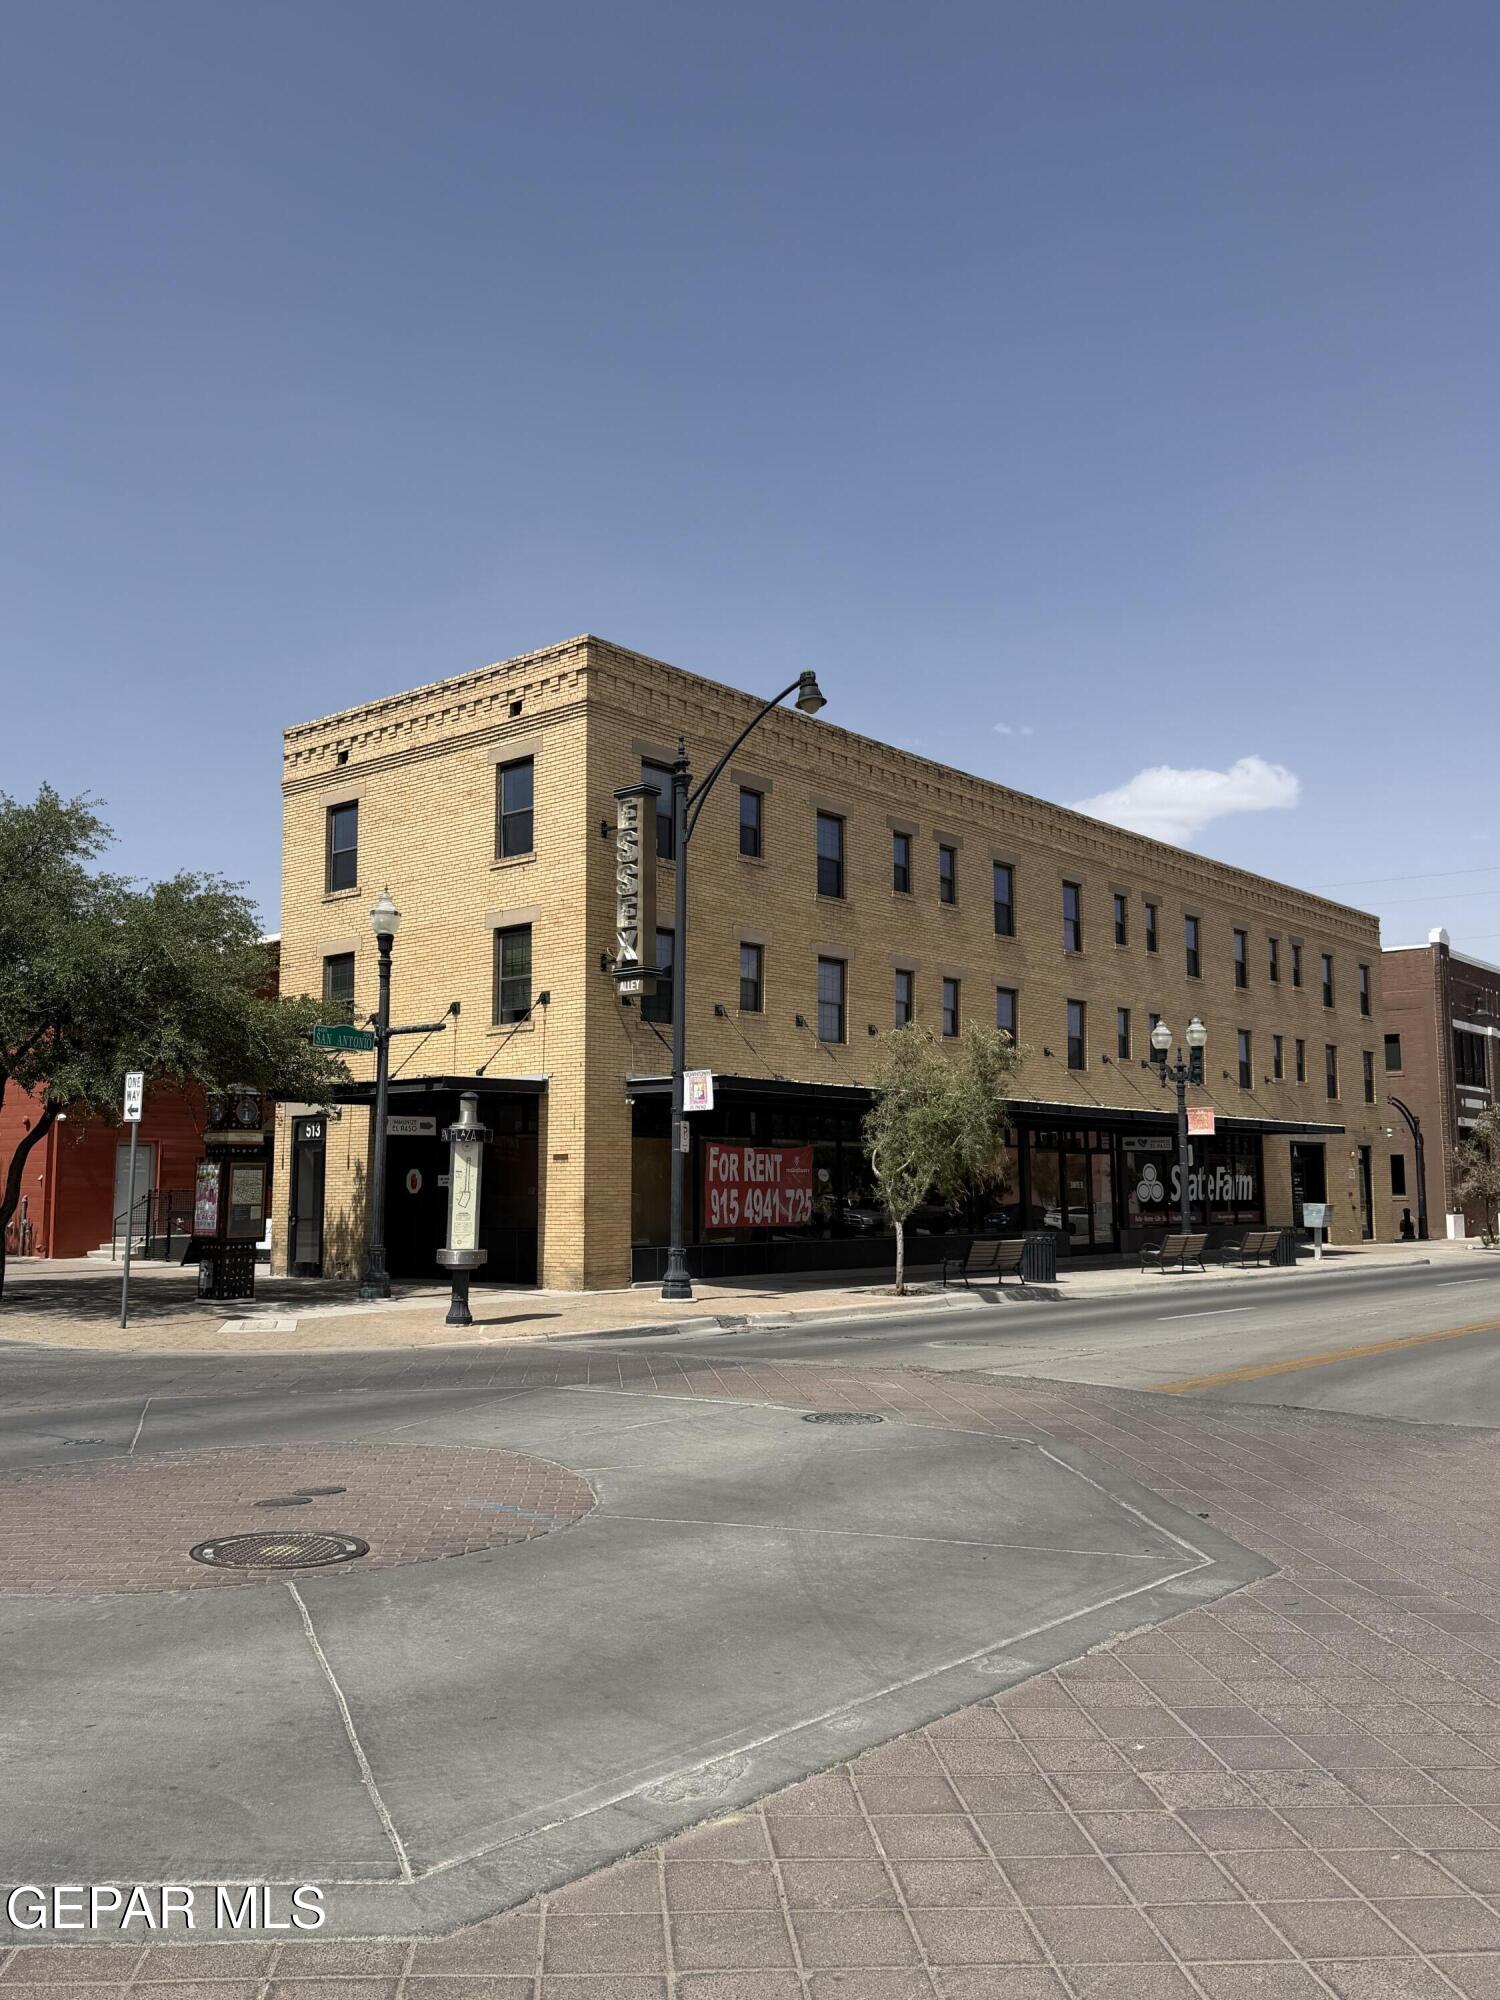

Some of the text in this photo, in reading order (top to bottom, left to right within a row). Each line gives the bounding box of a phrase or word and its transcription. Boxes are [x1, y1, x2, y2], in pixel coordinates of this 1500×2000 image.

[616, 799, 639, 962] ESSEX
[619, 979, 640, 992] ALLEY
[316, 1032, 372, 1049] SAN ANTONIO
[128, 1077, 141, 1088] ONE
[127, 1090, 141, 1101] WAY
[306, 1122, 321, 1138] 513
[450, 1129, 476, 1141] PLAZA
[709, 1146, 783, 1182] FOR RENT
[711, 1188, 740, 1224] 915
